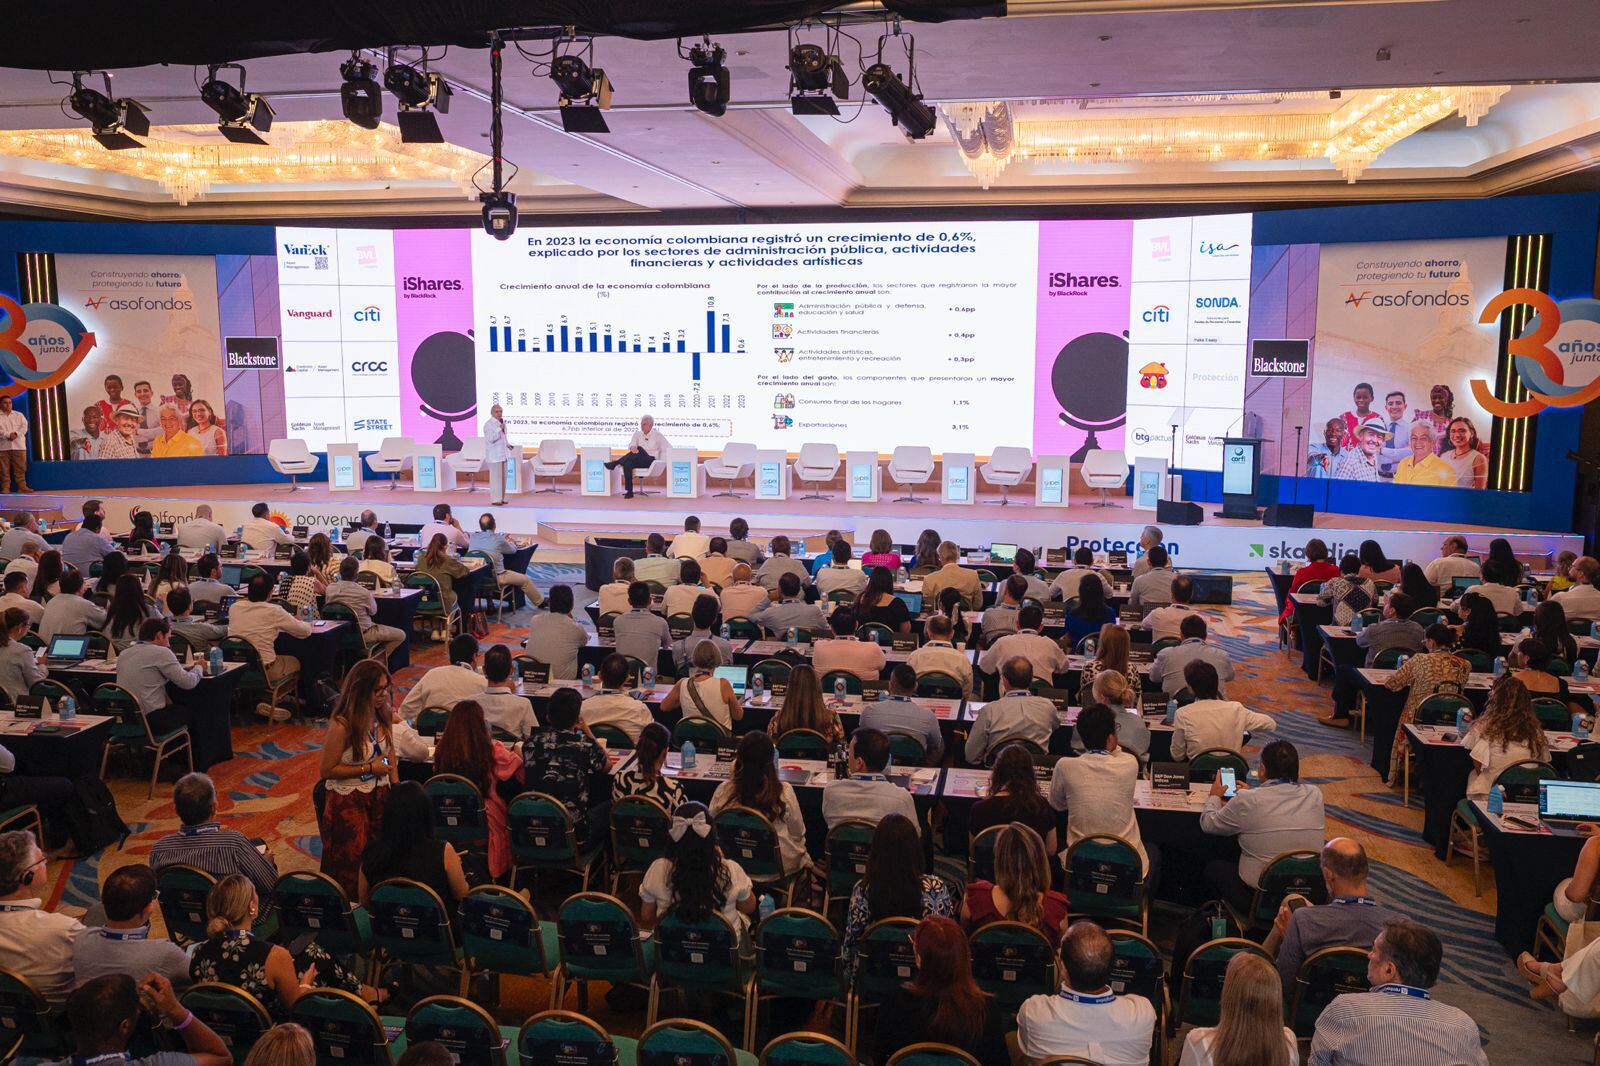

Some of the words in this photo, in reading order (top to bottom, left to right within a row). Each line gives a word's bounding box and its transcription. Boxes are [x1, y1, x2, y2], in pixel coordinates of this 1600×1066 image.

[528, 238, 542, 246] En
[546, 237, 576, 245] 2023
[579, 237, 591, 245] la
[595, 235, 662, 245] economía
[666, 235, 748, 244] colombiana
[752, 233, 802, 245] registró
[827, 233, 912, 242] crecimiento
[916, 233, 935, 241] de
[939, 232, 976, 242] 0,6%,
[284, 244, 327, 255] VanEck
[528, 248, 594, 258] explicado
[597, 250, 619, 258] por
[623, 248, 641, 256] los
[644, 247, 700, 256] sectores
[703, 247, 721, 255] de
[725, 245, 826, 257] administración
[830, 245, 887, 256] pública,
[892, 244, 976, 253] actividades
[1200, 241, 1238, 254] isa
[630, 258, 703, 267] financieras
[707, 260, 715, 268] y
[719, 257, 798, 266] actividades
[802, 255, 863, 265] artísticas
[1356, 260, 1422, 270] Construyendo
[1425, 259, 1461, 268] ahorro,
[91, 271, 149, 281] Construyendo
[151, 271, 181, 279] ahorro,
[1049, 273, 1120, 287] iShares
[1356, 271, 1414, 282] protegiendo
[1429, 270, 1460, 278] futuro
[92, 280, 143, 288] protegiendo
[403, 277, 462, 290] iShares
[110, 297, 192, 310] asofondos
[1196, 297, 1238, 308] SONDA
[1372, 290, 1469, 308] asofondos
[287, 309, 332, 319] Vanguard
[354, 308, 380, 321] citi
[1143, 308, 1169, 322] citi
[28, 334, 65, 345] años
[40, 345, 70, 355] juntos
[229, 352, 276, 366] Blackstone
[1570, 353, 1600, 364] junto
[1254, 358, 1305, 373] Blackstone
[1192, 372, 1239, 382] Protección
[1136, 432, 1149, 442] btg
[297, 514, 358, 526] porvenir
